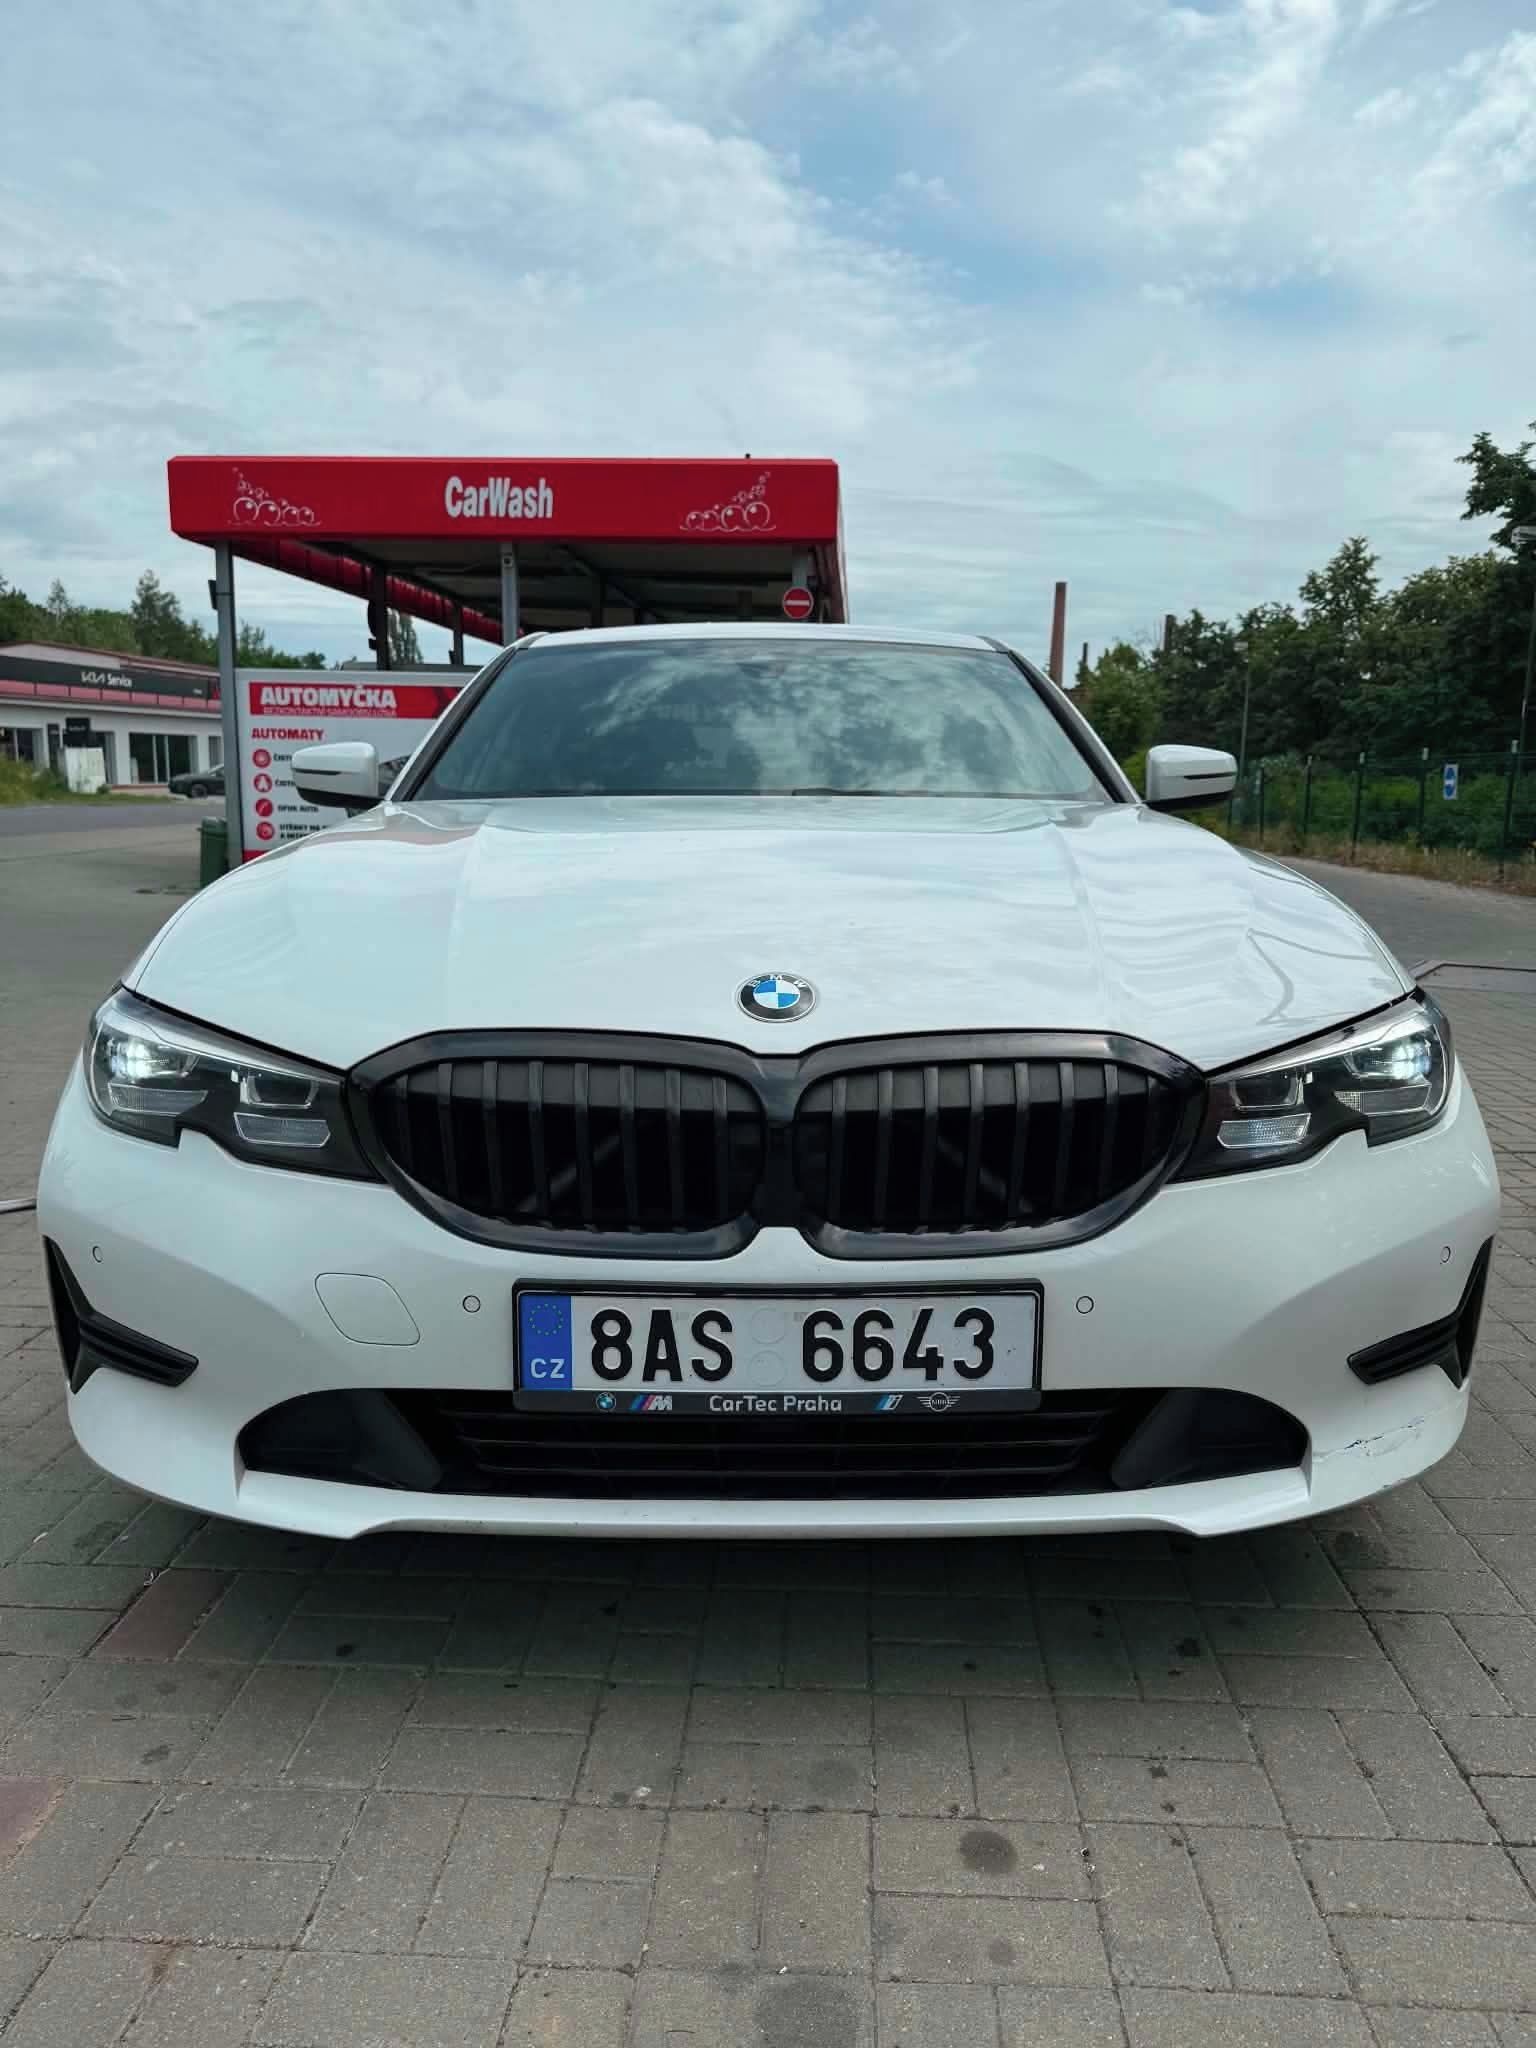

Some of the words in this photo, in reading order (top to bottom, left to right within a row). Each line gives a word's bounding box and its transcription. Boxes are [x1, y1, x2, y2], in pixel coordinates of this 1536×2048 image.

[444, 475, 554, 519] CarWash
[260, 685, 397, 709] AUTOMYČKA
[251, 727, 325, 741] AUTOMATY
[590, 1308, 734, 1383] 8AS
[802, 1307, 996, 1383] 6643
[530, 1358, 565, 1380] CZ
[709, 1395, 777, 1412] CarTec
[783, 1395, 842, 1412] Praha
